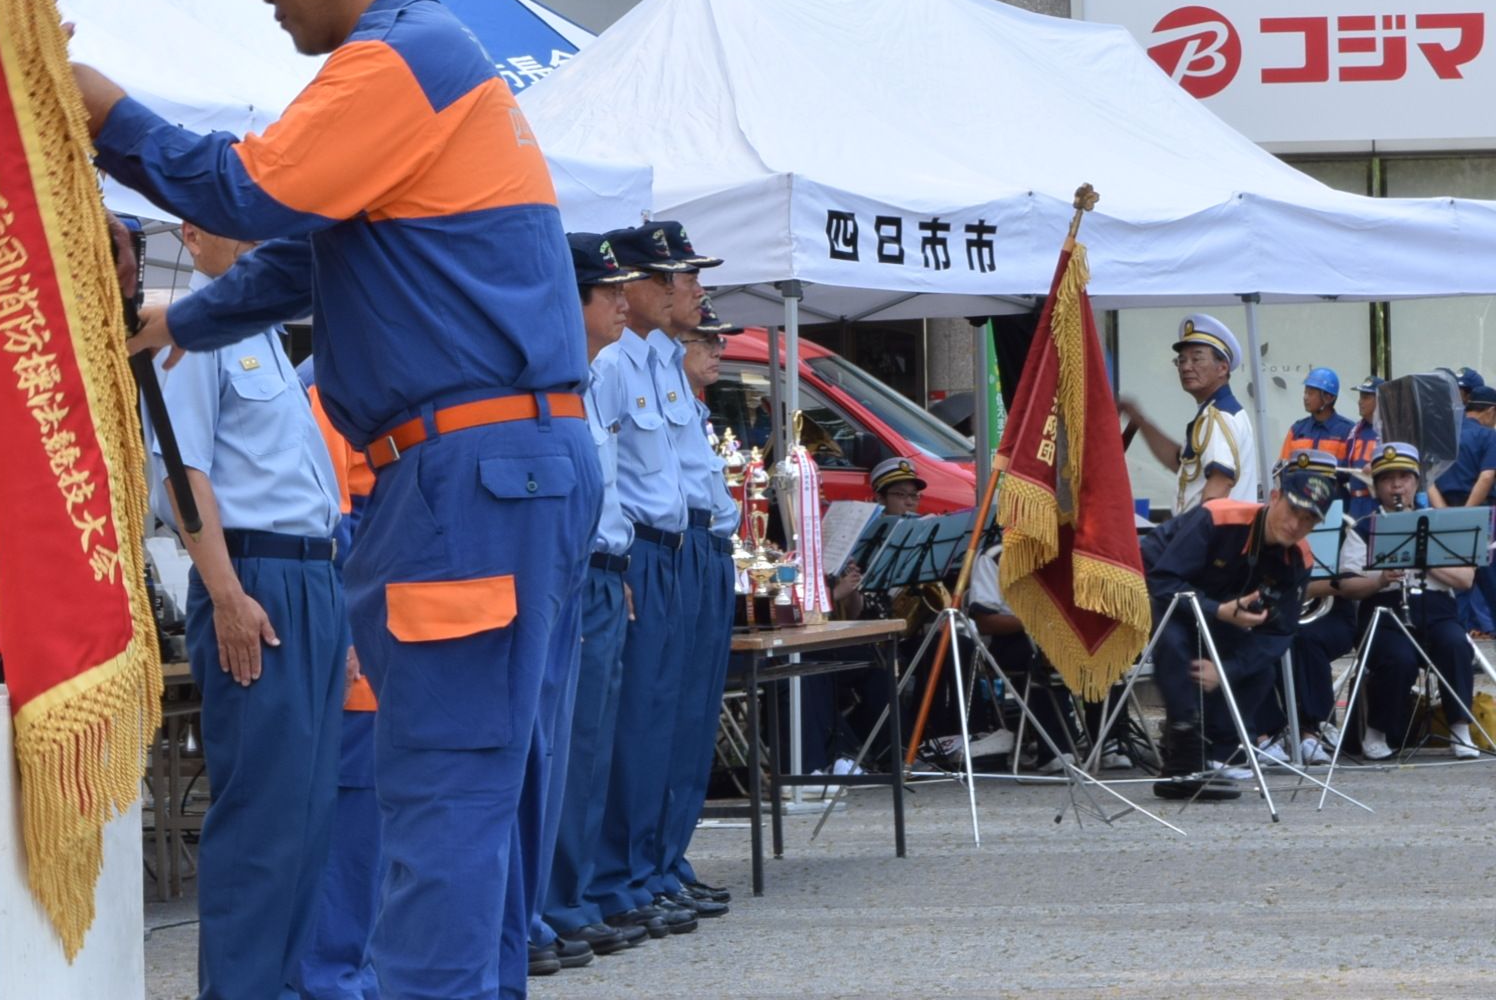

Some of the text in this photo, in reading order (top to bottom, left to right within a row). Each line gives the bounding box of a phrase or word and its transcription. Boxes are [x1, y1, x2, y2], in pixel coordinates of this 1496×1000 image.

[1260, 12, 1484, 84] コジマ
[825, 209, 997, 273] 四日市市
